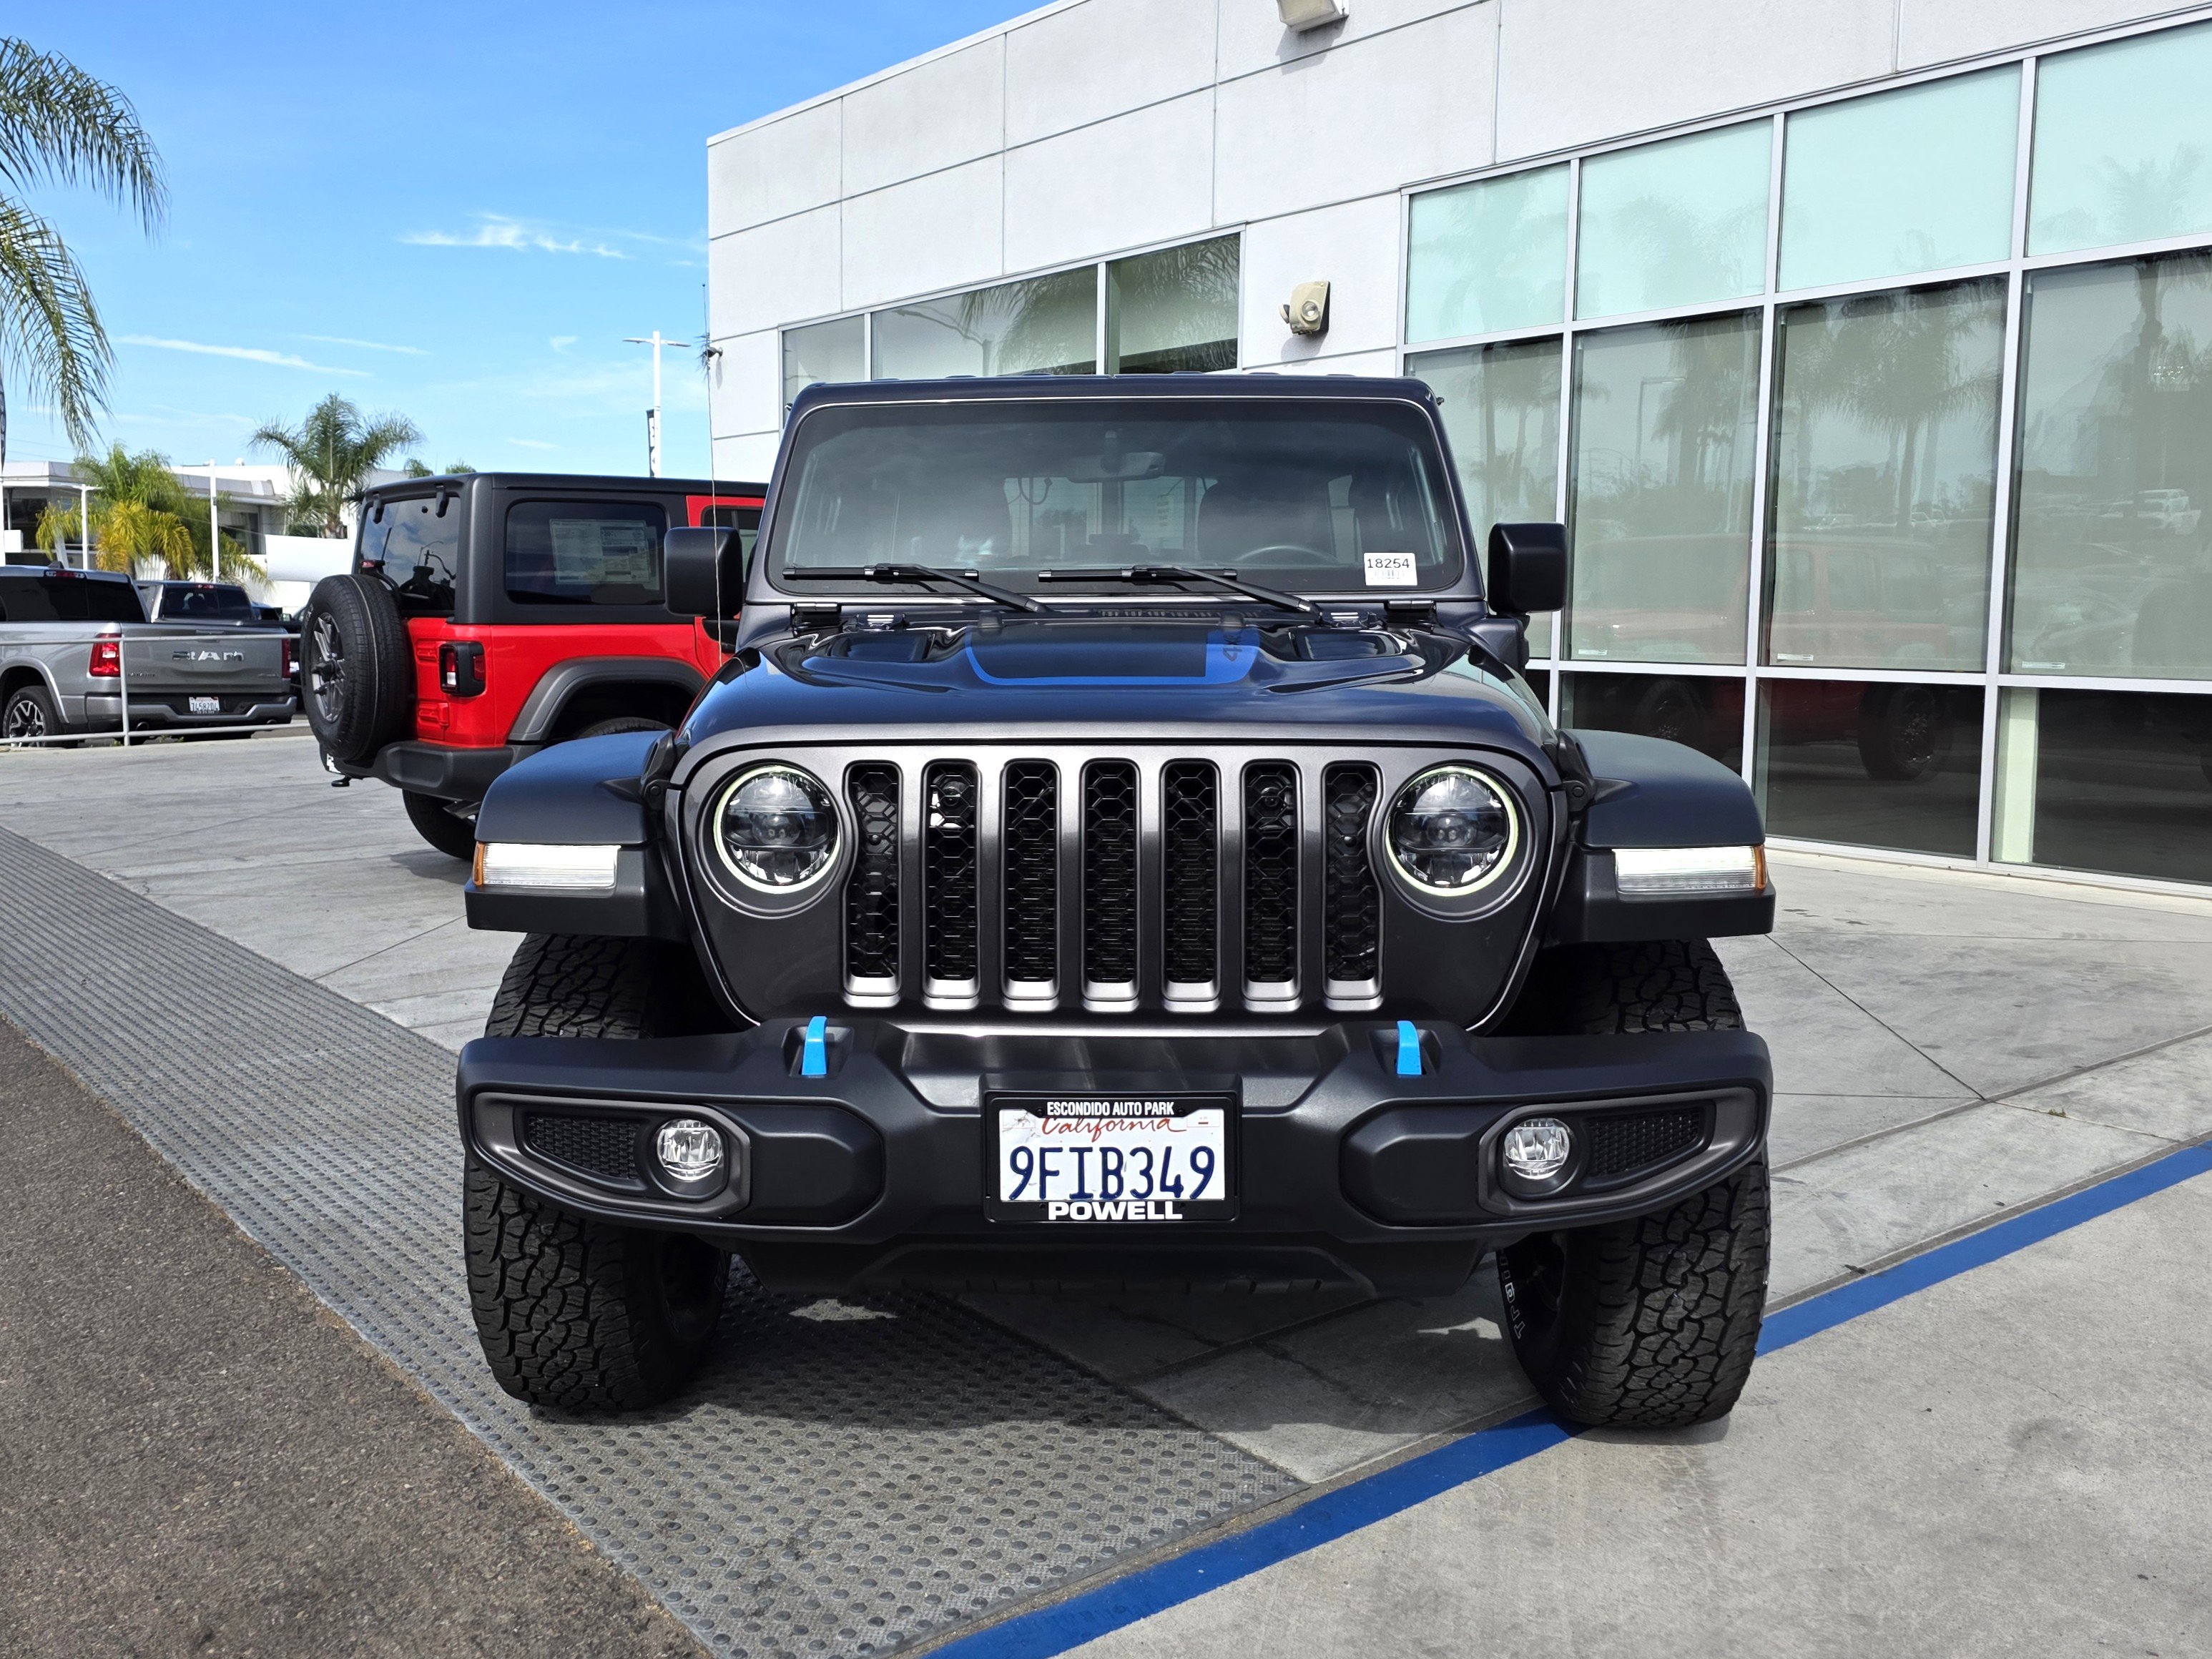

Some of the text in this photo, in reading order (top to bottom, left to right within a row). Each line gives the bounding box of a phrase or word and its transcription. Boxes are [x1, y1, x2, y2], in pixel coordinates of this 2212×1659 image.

[1367, 558, 1410, 568] 18254
[172, 651, 245, 661] RAM
[1047, 1101, 1175, 1116] ESCONDIDO AUTO PARK
[1042, 1116, 1187, 1143] California
[1008, 1146, 1216, 1200] 9FIB349
[1048, 1201, 1184, 1221] POWELL
